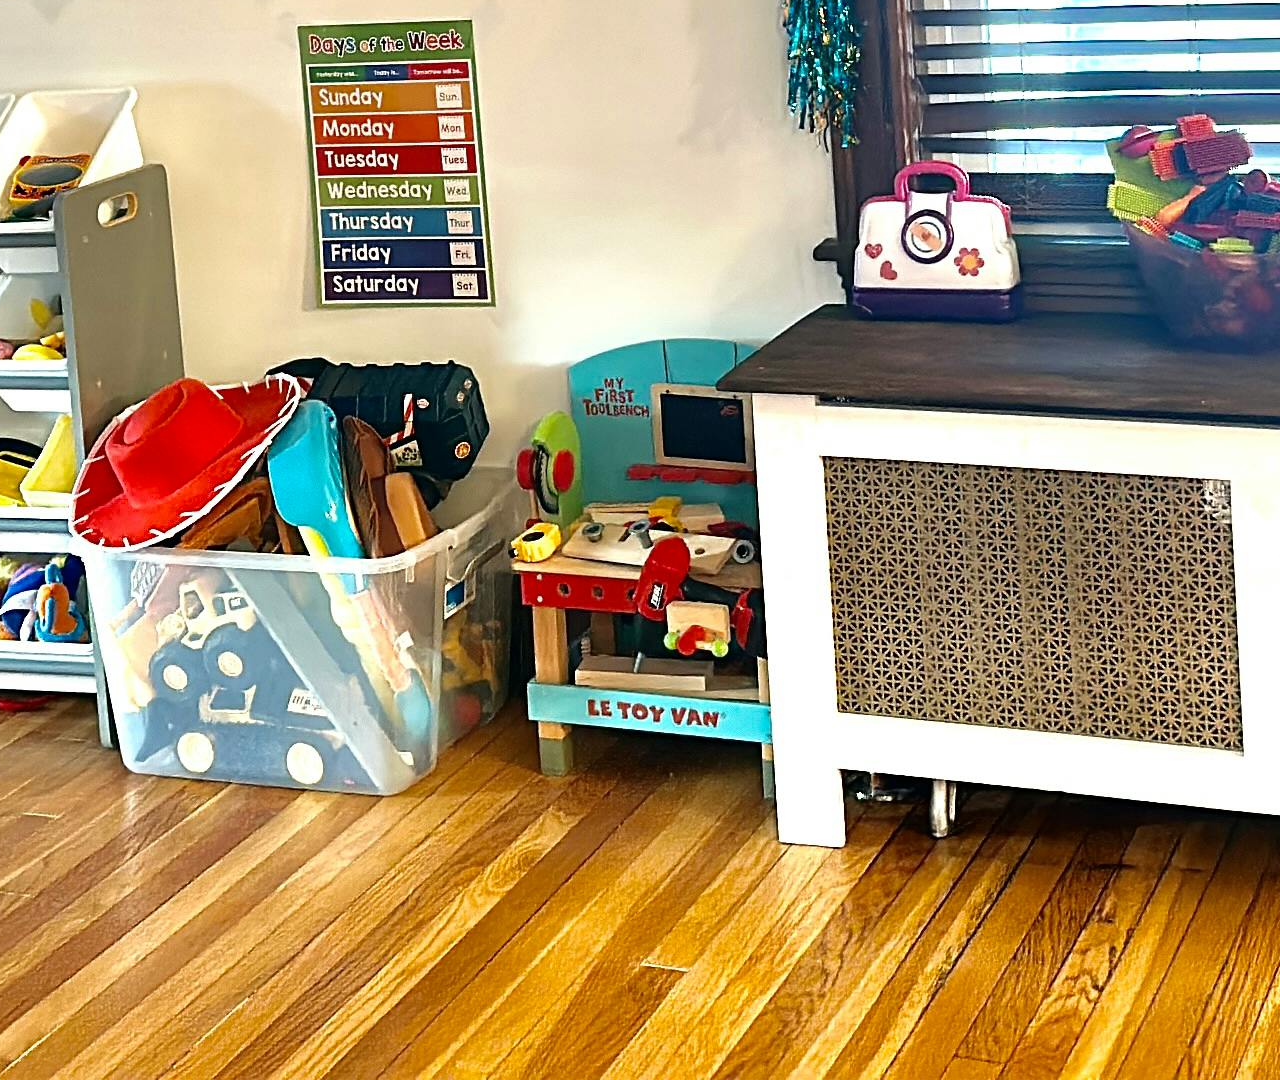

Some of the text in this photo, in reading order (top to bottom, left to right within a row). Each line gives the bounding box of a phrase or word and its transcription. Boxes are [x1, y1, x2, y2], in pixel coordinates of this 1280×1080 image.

[309, 28, 464, 57] Days of the Week
[319, 88, 383, 109] Sunday
[439, 92, 460, 102] Sun.
[322, 118, 395, 139] Monday
[324, 149, 399, 170] Tuesday
[443, 155, 467, 164] Tues.
[327, 181, 433, 201] Wednesday
[329, 212, 414, 232] Thursday
[330, 243, 391, 265] Friday
[455, 249, 472, 259] Fri.
[332, 274, 419, 296] Saturday
[604, 376, 624, 389] MY
[594, 388, 635, 404] FIRST
[587, 699, 612, 717] LE
[617, 701, 665, 723] TOY
